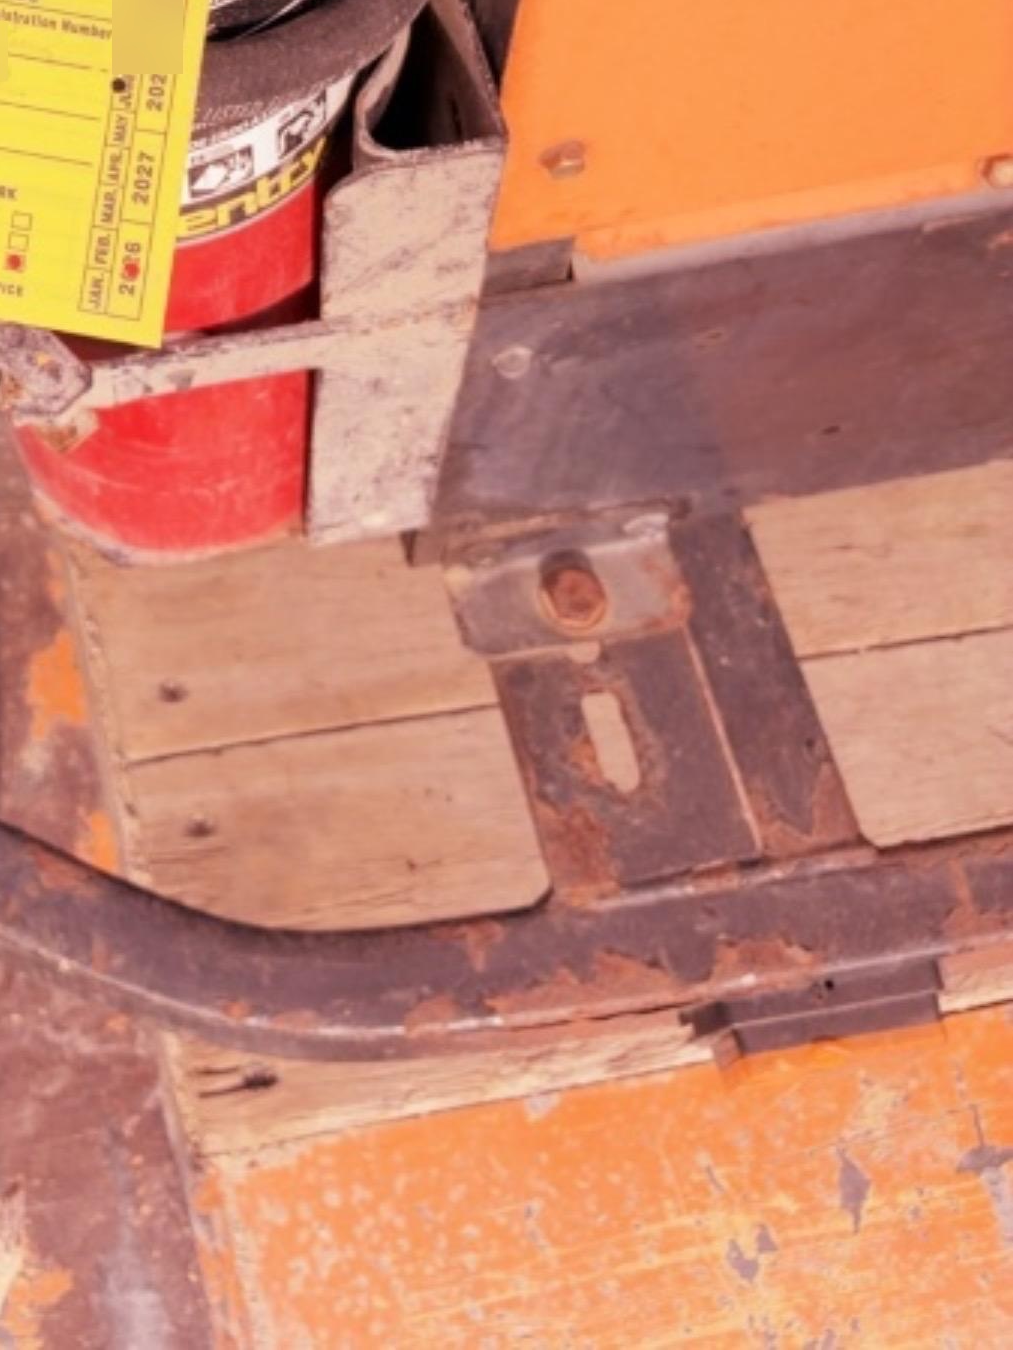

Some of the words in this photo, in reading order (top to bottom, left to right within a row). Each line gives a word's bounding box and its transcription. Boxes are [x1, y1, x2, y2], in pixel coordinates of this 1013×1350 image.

[60, 19, 112, 40] Number
[119, 74, 135, 108] JU
[146, 74, 167, 112] 202
[114, 115, 126, 143] MAY
[107, 152, 122, 184] APR.
[132, 152, 155, 205] 2027
[101, 188, 117, 224] MAR.
[94, 233, 110, 265] FEB.
[118, 241, 142, 296] 26
[88, 272, 104, 309] JAN.
